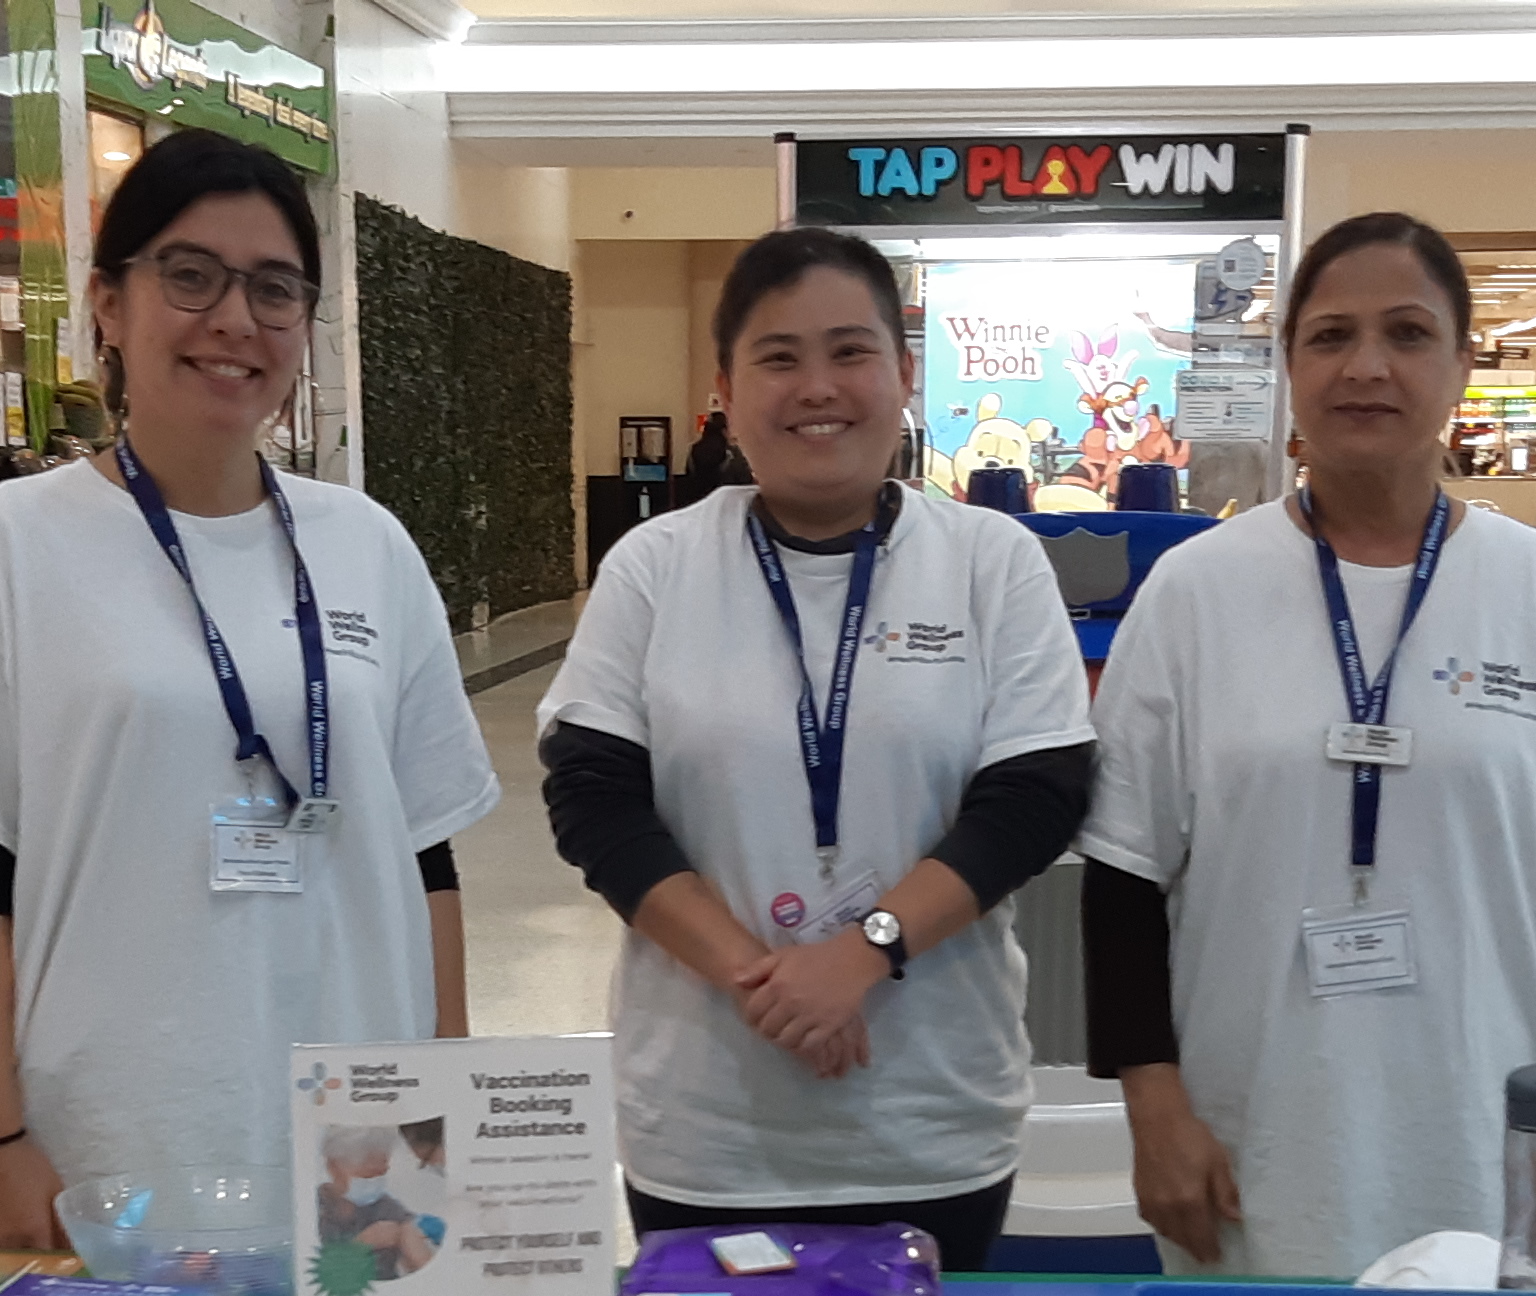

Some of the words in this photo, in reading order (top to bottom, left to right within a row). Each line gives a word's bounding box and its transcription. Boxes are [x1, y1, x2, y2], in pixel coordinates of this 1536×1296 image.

[848, 145, 958, 196] TAP
[967, 144, 1113, 196] PLAY
[1118, 143, 1235, 194] WIN
[946, 317, 1049, 343] Winnie
[964, 346, 1036, 376] Pooh
[470, 1068, 590, 1090] Vaccination
[490, 1094, 572, 1116] Booking
[476, 1119, 587, 1138] Assistance
